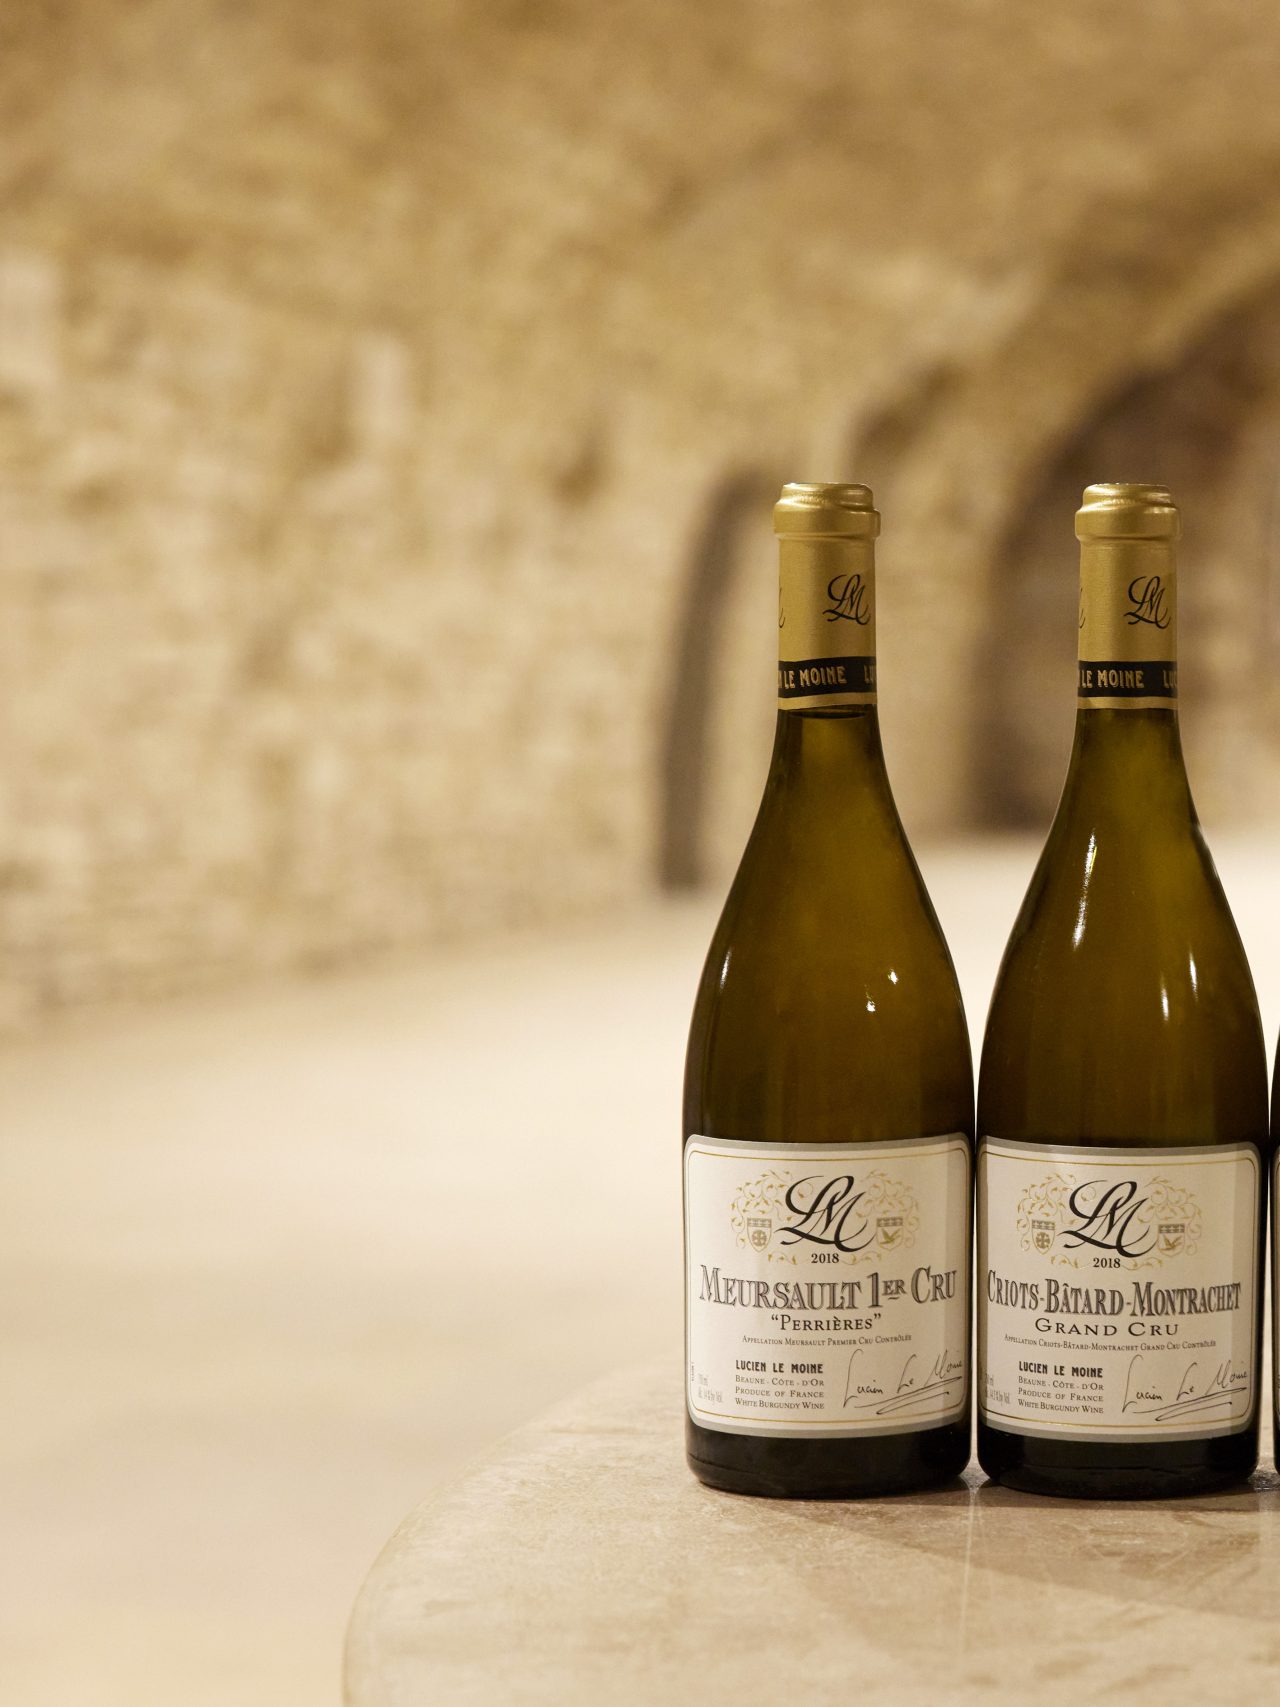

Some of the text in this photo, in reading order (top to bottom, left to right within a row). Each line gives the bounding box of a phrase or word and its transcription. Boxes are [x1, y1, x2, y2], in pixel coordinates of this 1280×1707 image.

[784, 670, 795, 689] LE
[800, 666, 847, 687] MOINE
[1082, 670, 1093, 688] LE
[1098, 670, 1144, 688] MOINE
[811, 1253, 839, 1263] 2018
[1093, 1258, 1121, 1268] 2018
[700, 1265, 862, 1310] MEURSAULT
[911, 1266, 957, 1304] CRU
[988, 1269, 1241, 1316] CRIOTS-BÂTARD-MONTRACHET
[1035, 1318, 1178, 1336] GRAND CRU
[742, 1335, 782, 1344] APPELLATION
[1005, 1334, 1037, 1348] APPELLATION
[1140, 1342, 1165, 1350] GRAND
[1167, 1341, 1180, 1350] CRU
[736, 1360, 823, 1373] LUCIEN LE MOINE
[1019, 1361, 1103, 1377] LUCIEN LE MOINE
[736, 1375, 764, 1384] BEAUNE
[772, 1377, 794, 1386] CÔTE
[1018, 1376, 1046, 1386] BEAUNE
[1053, 1380, 1073, 1389] CÔTE
[735, 1386, 770, 1396] PRODUCE
[1018, 1388, 1051, 1398] PRODUCE
[1070, 1393, 1103, 1401] FRANCE
[735, 1398, 757, 1407] WHITE
[759, 1400, 800, 1409] BURGUNDY
[1018, 1399, 1104, 1413] WHITE BURGUNDY WINE
